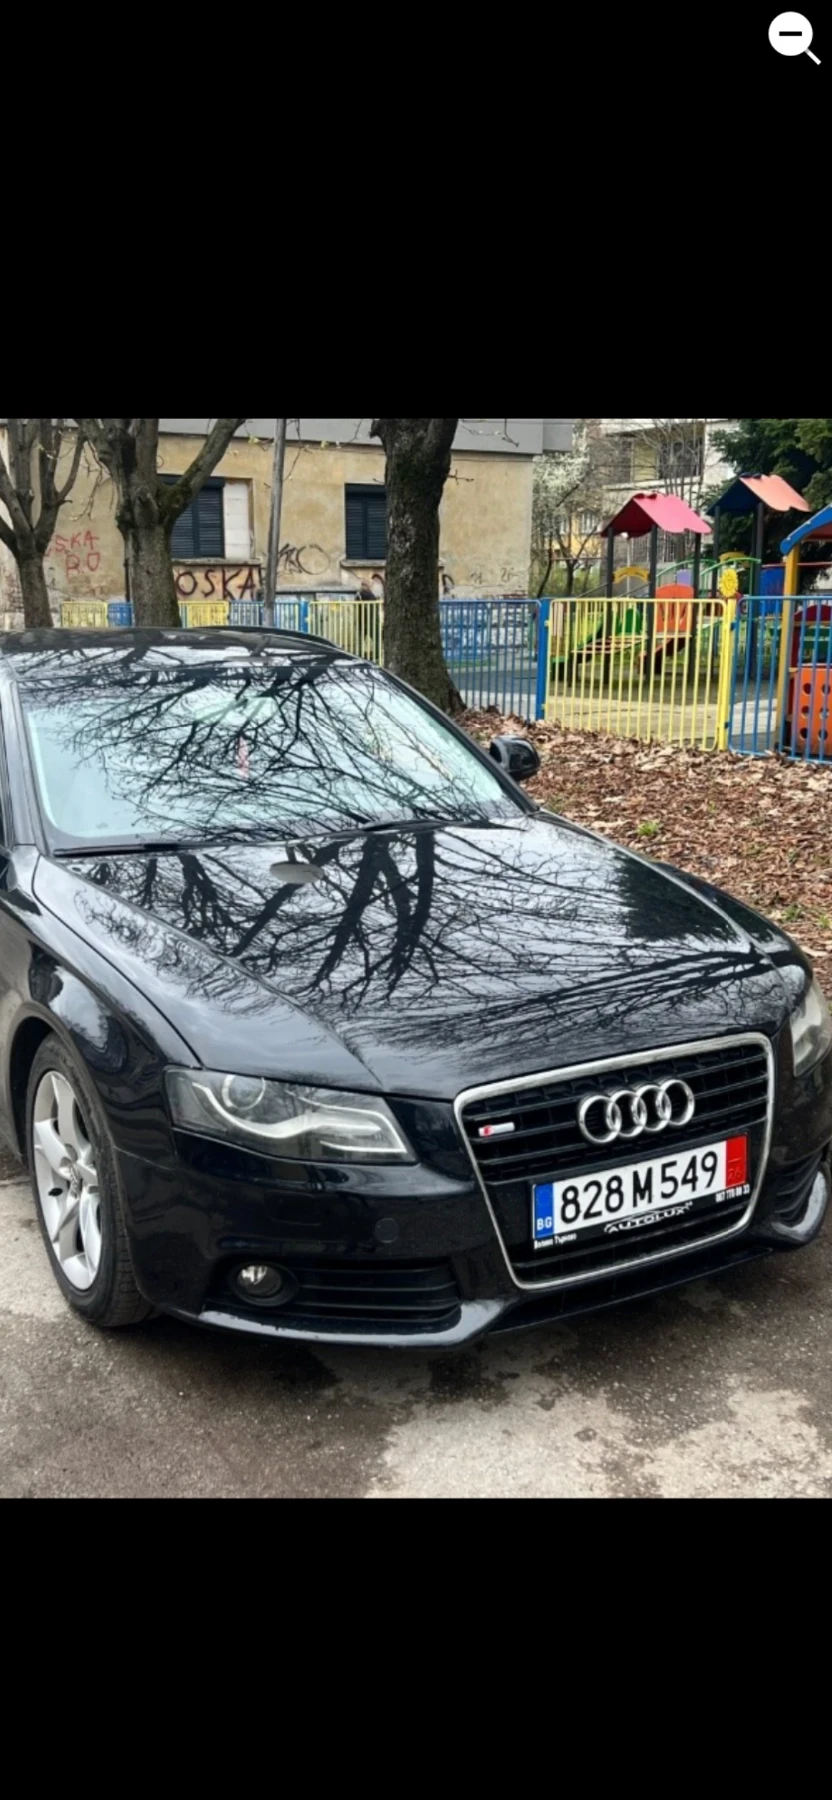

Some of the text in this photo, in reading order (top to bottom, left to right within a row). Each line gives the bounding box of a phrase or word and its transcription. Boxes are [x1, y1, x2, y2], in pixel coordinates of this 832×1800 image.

[561, 1151, 718, 1224] 828 M 549
[537, 1216, 552, 1231] BG
